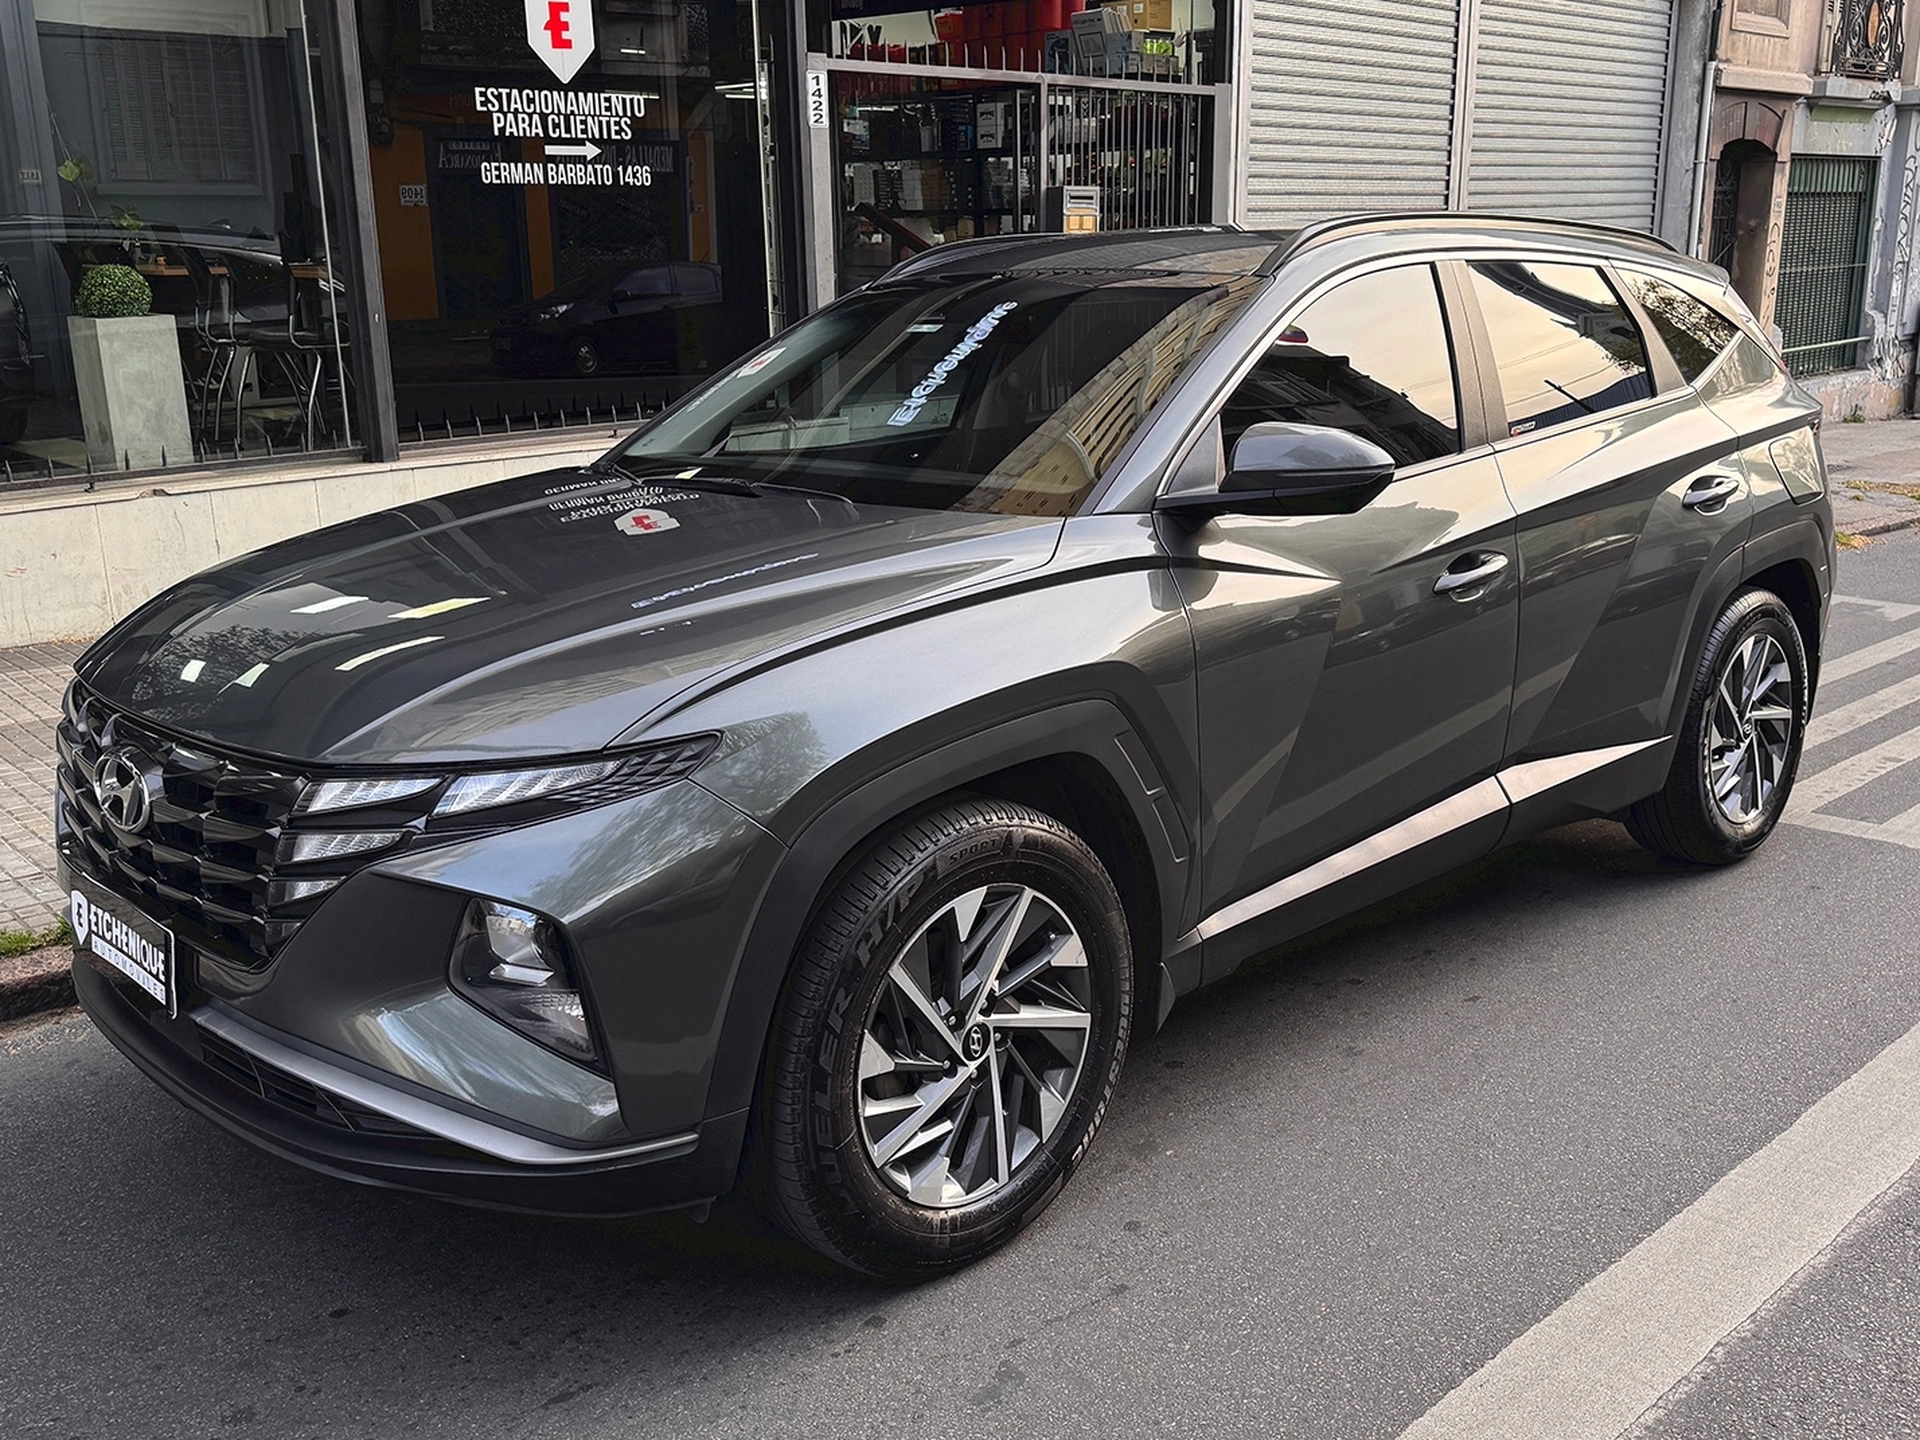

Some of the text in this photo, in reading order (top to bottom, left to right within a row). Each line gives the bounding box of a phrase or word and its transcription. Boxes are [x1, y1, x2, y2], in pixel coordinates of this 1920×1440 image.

[474, 87, 645, 118] ESTACIONAMIENTO
[811, 74, 824, 124] 1422
[492, 112, 632, 140] PARA CLIENTES
[480, 162, 651, 187] GERMAN BARBATO 1436
[948, 836, 1000, 866] SPORT
[89, 903, 166, 983] ETCHENIQUE
